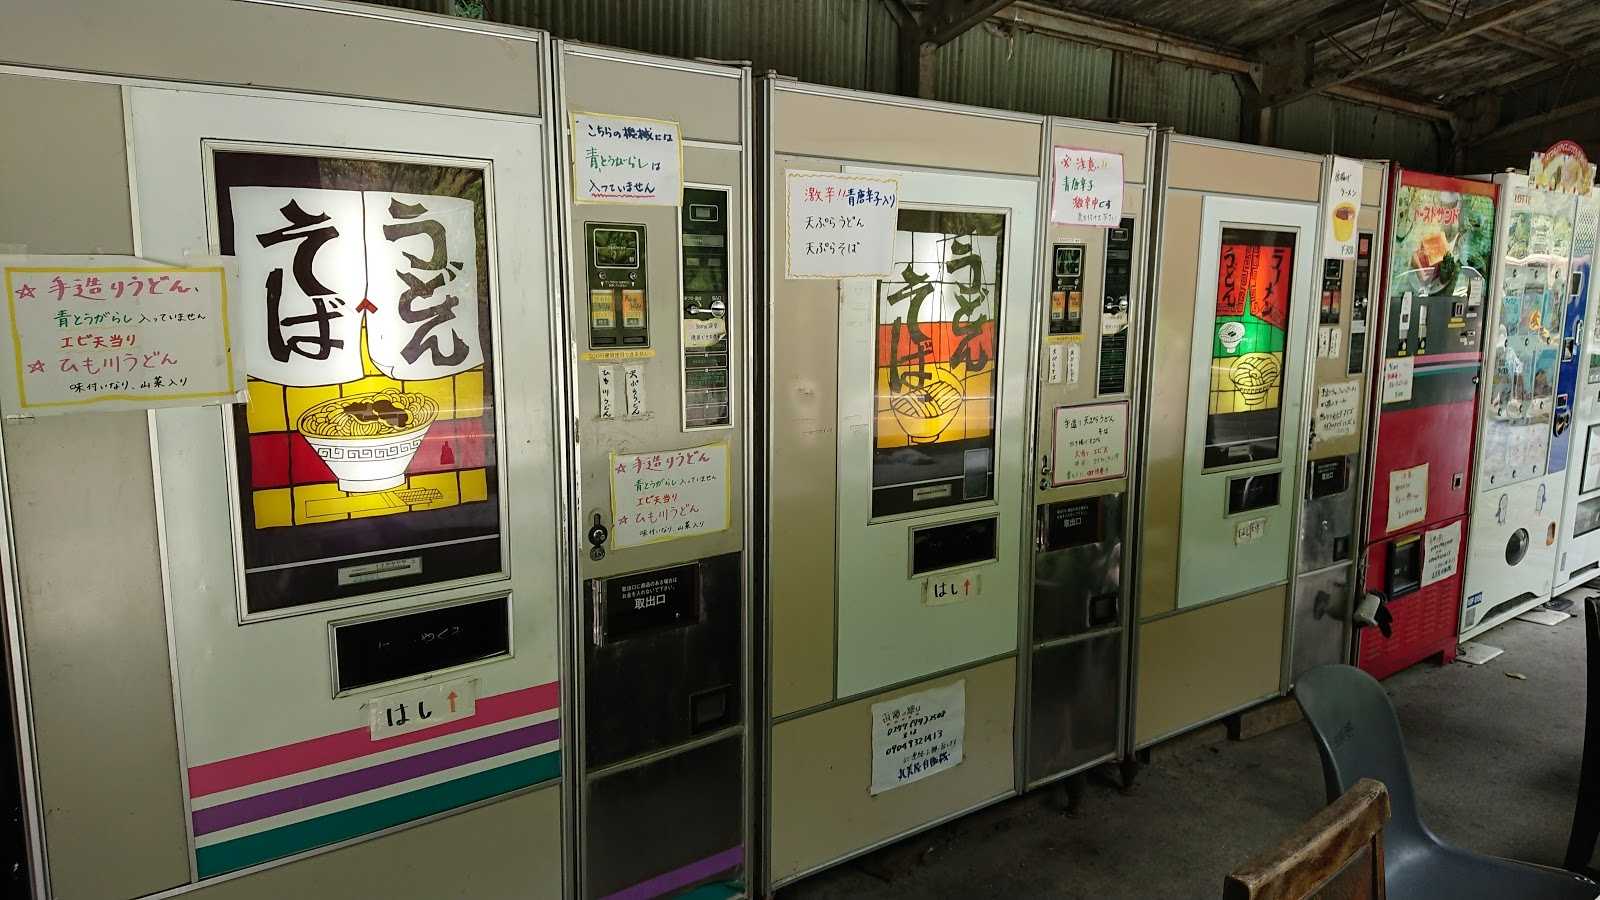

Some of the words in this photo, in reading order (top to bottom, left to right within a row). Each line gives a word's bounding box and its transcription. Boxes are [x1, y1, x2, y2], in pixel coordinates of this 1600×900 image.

[588, 124, 673, 142] こちらの機械には
[589, 179, 656, 194] 入っていません
[805, 215, 865, 230] 天ぷらうどん
[806, 241, 861, 256] 天ぷらそば
[256, 198, 346, 363] そば
[383, 196, 470, 367] うどん
[1223, 247, 1236, 308] うどん
[1262, 248, 1284, 316] ラーメン
[946, 239, 990, 372] うどん
[887, 262, 935, 393] そば
[61, 333, 137, 349] エビ天当り
[60, 352, 178, 375] ひも川うどん
[601, 369, 612, 418] ひも川うどん
[633, 451, 710, 473] 手造りうどん
[636, 493, 678, 507] エビ天当り
[635, 504, 700, 523] ひも川うどん
[935, 582, 958, 598] はし
[634, 594, 666, 610] 取出口
[386, 700, 432, 727] はし
